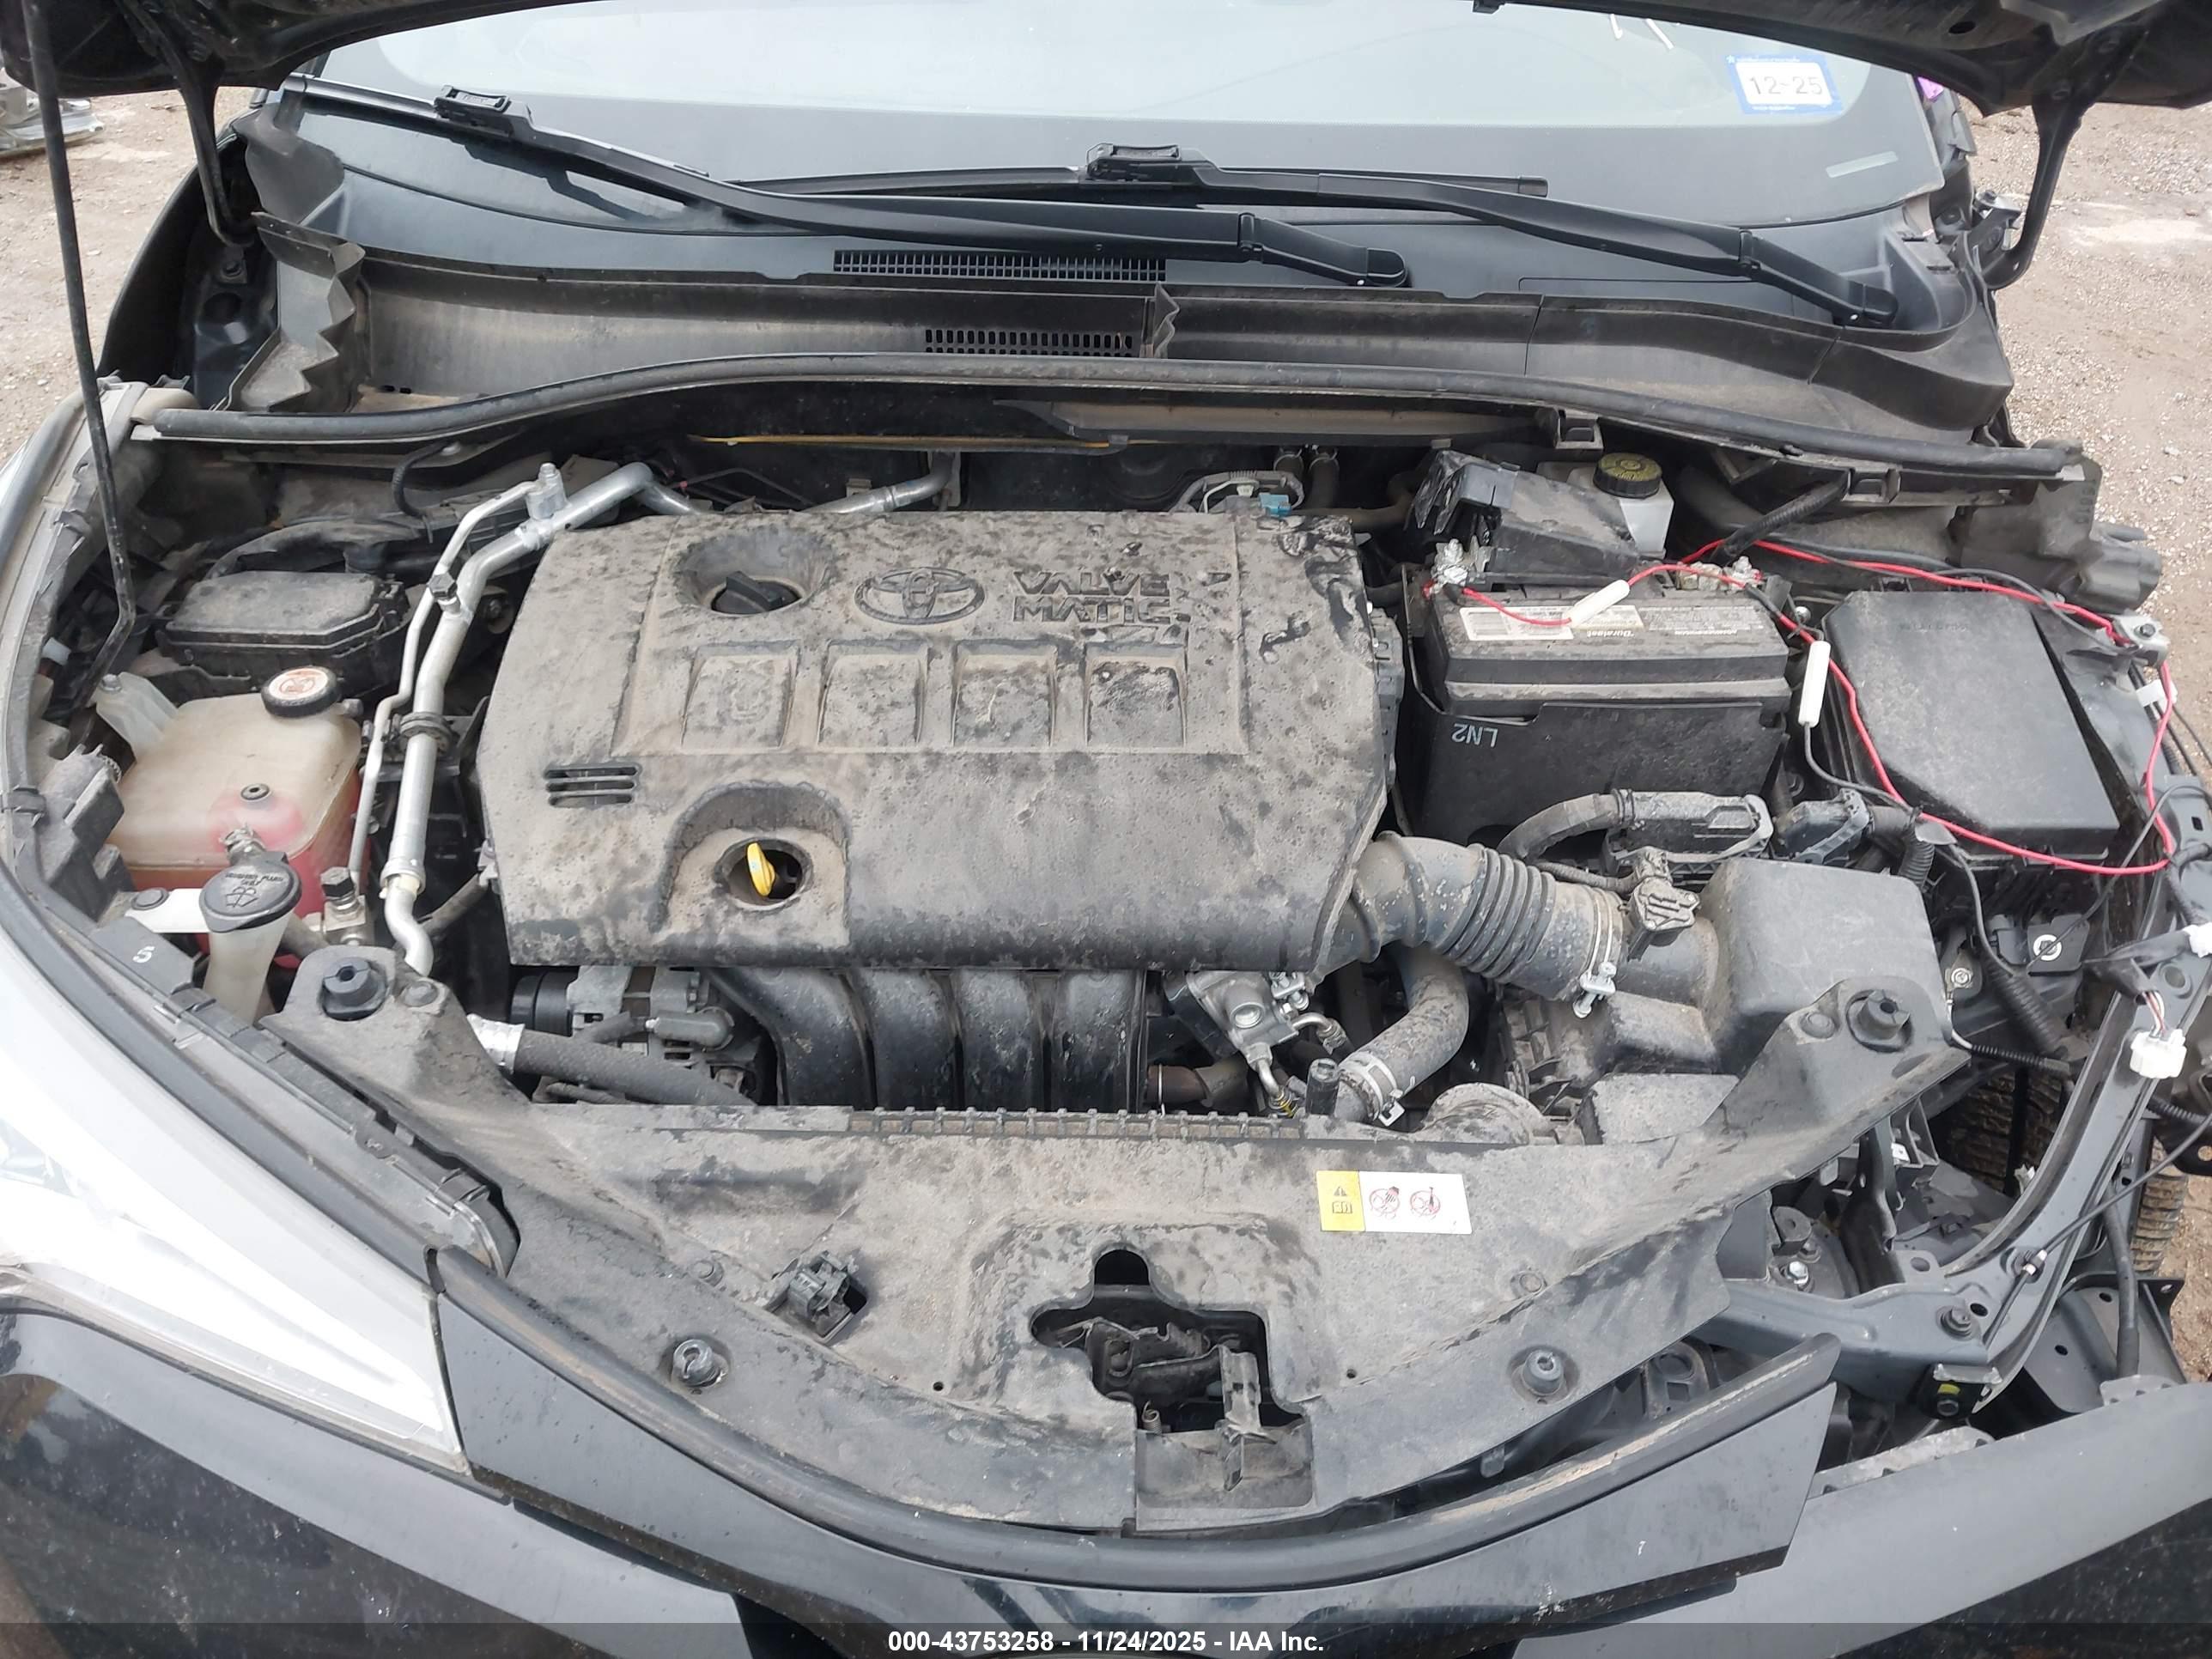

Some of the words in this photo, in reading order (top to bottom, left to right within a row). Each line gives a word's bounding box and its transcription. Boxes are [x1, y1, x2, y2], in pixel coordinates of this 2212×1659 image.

[1748, 76, 1823, 95] 12-25
[1012, 570, 1170, 596] VALVE
[1012, 596, 1171, 623] MATIC
[1451, 722, 1498, 748] LN2
